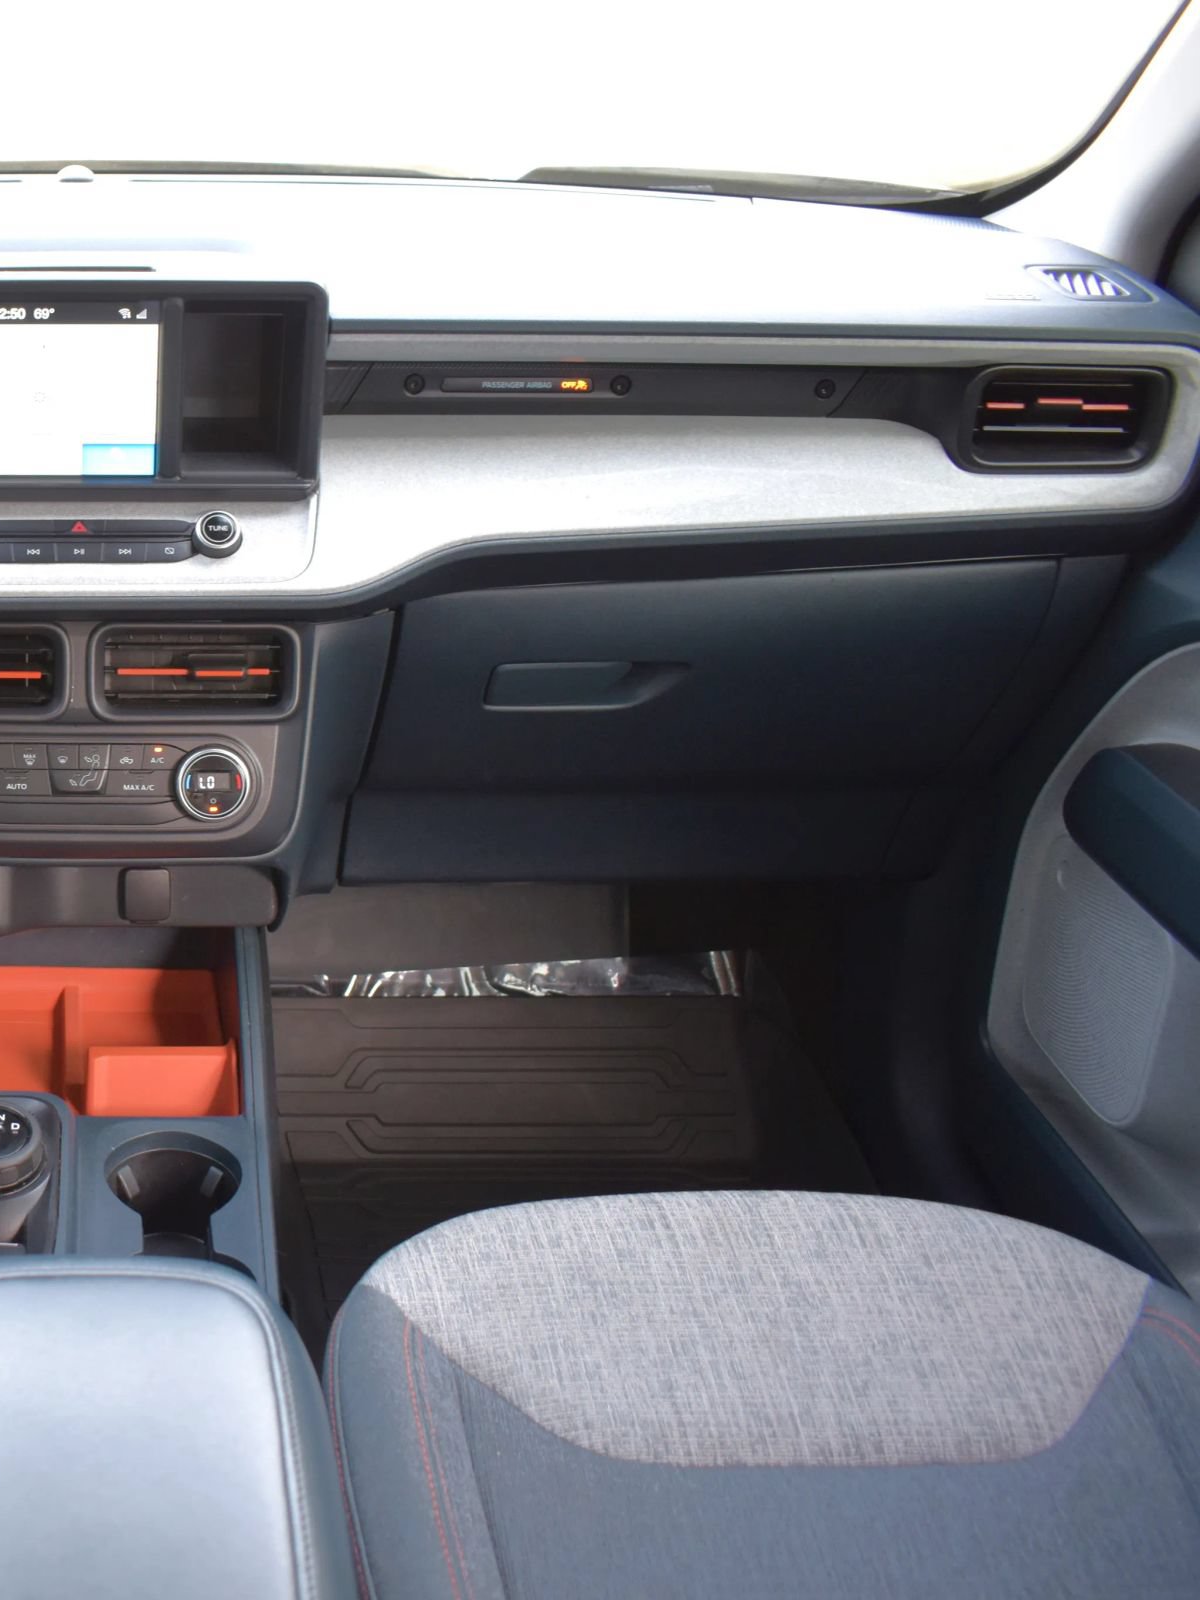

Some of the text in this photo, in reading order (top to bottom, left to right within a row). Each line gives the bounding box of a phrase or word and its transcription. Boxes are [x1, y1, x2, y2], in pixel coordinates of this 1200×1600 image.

[33, 307, 56, 321] 69°
[482, 381, 577, 390] PASSENGER AIRBAG OFF
[199, 776, 215, 790] LO
[10, 1122, 20, 1130] D
